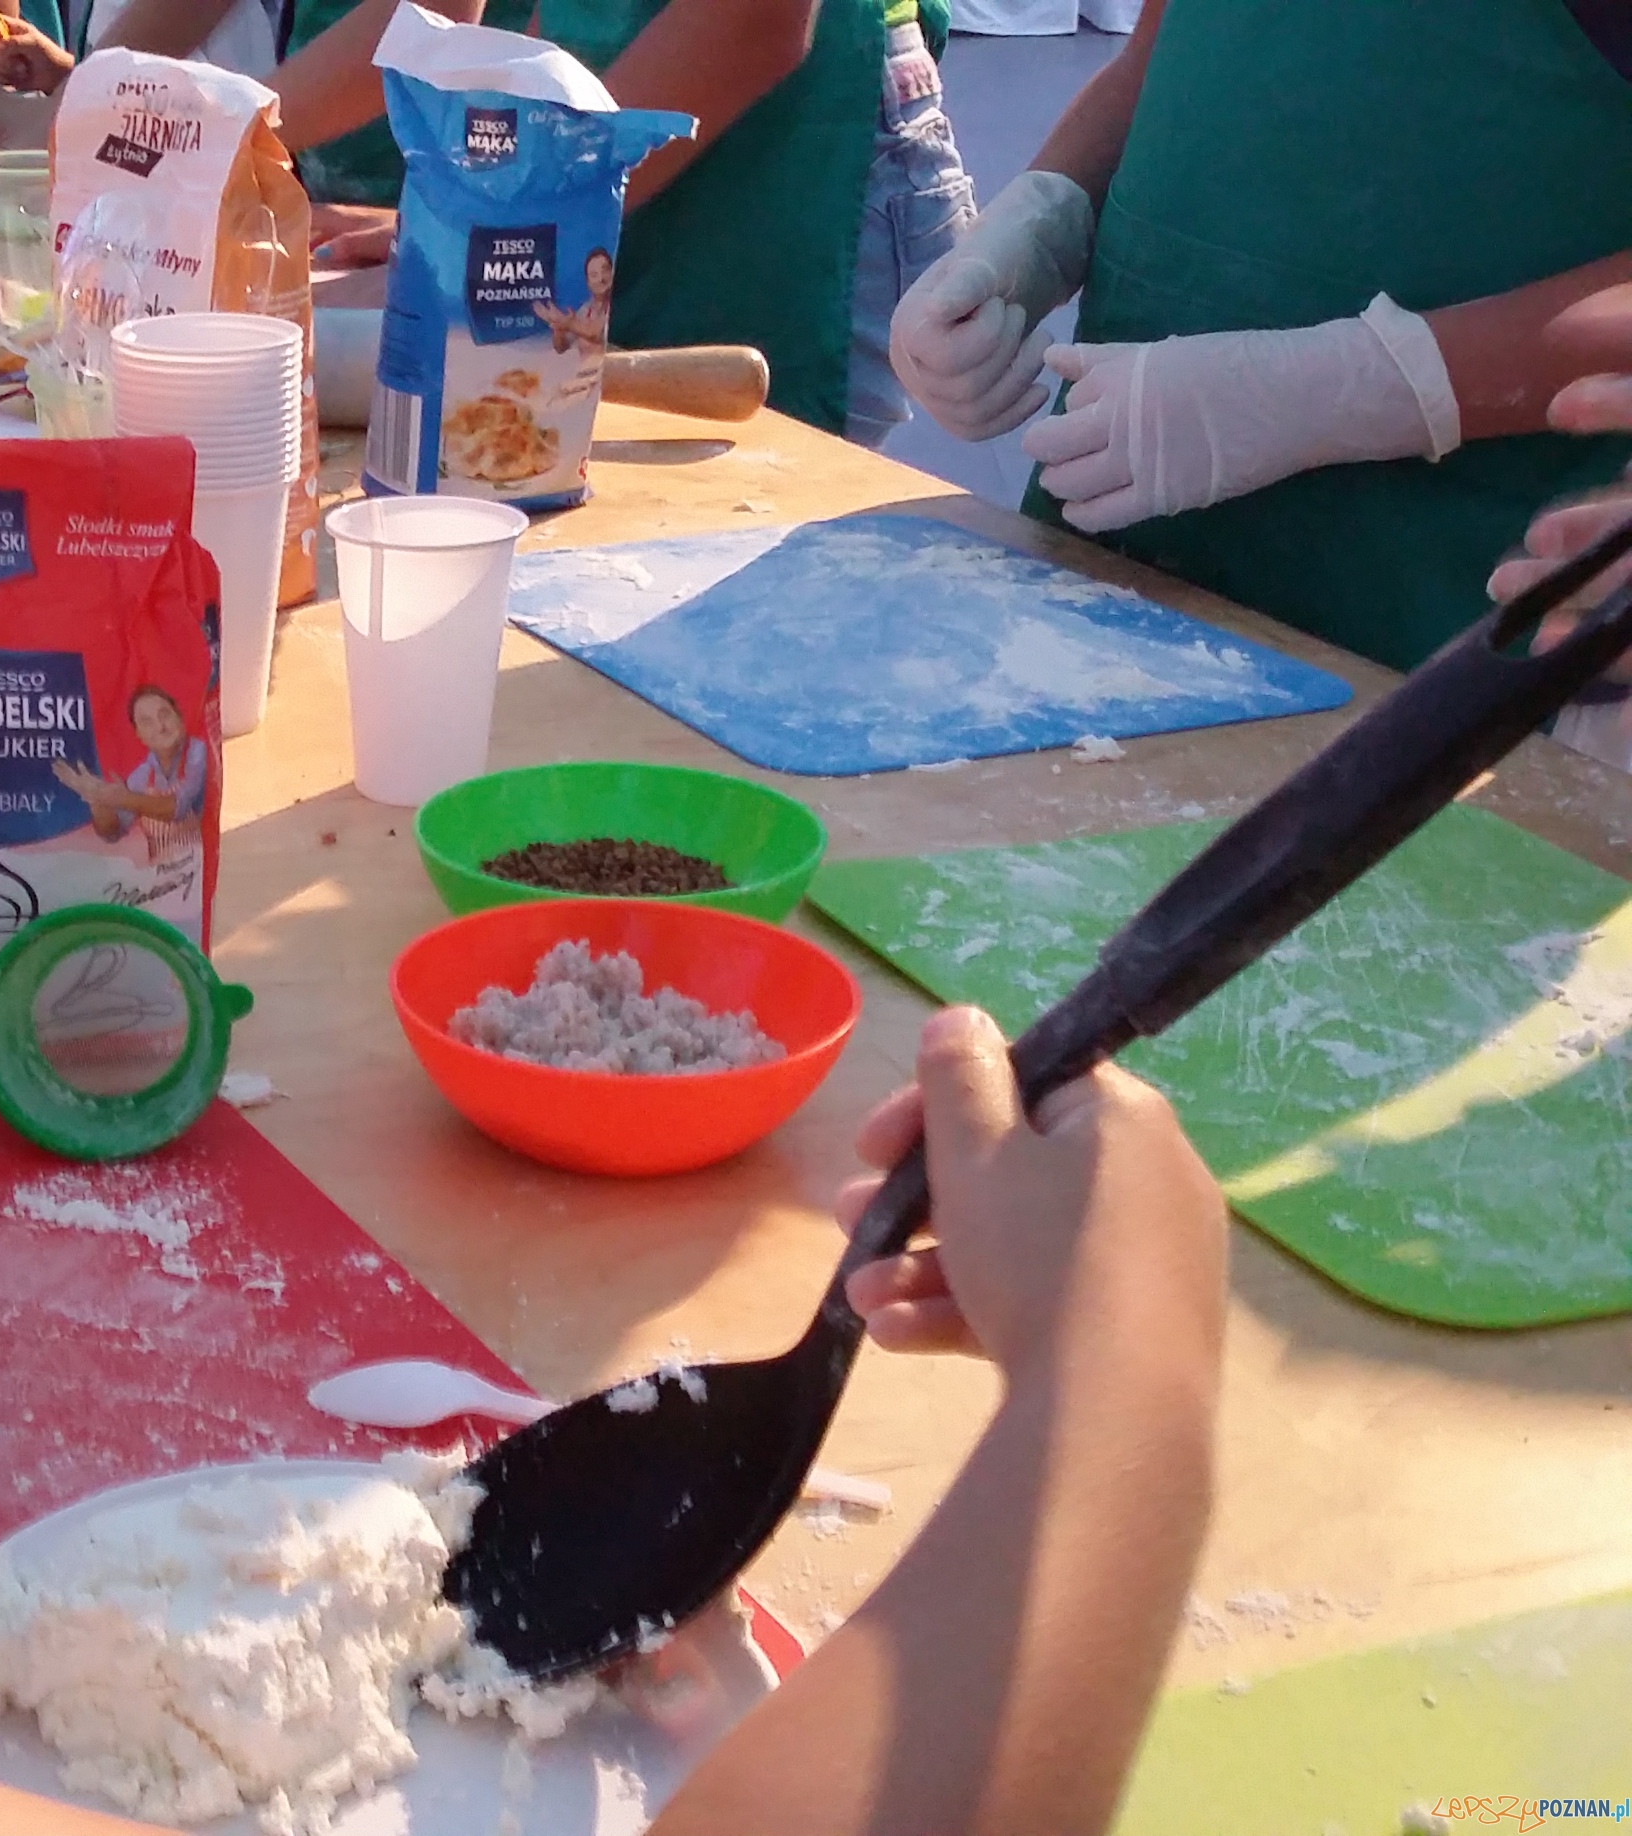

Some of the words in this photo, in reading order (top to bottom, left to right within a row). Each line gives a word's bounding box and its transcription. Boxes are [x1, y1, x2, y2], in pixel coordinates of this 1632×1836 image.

[472, 119, 509, 132] TESCO
[467, 135, 516, 154] MĄKA
[492, 238, 536, 255] TESCO
[153, 248, 202, 278] Młyny
[483, 260, 545, 284] MĄKA
[476, 286, 552, 302] POZNAŃSKA
[65, 514, 124, 535] Słodki
[126, 519, 176, 537] smak
